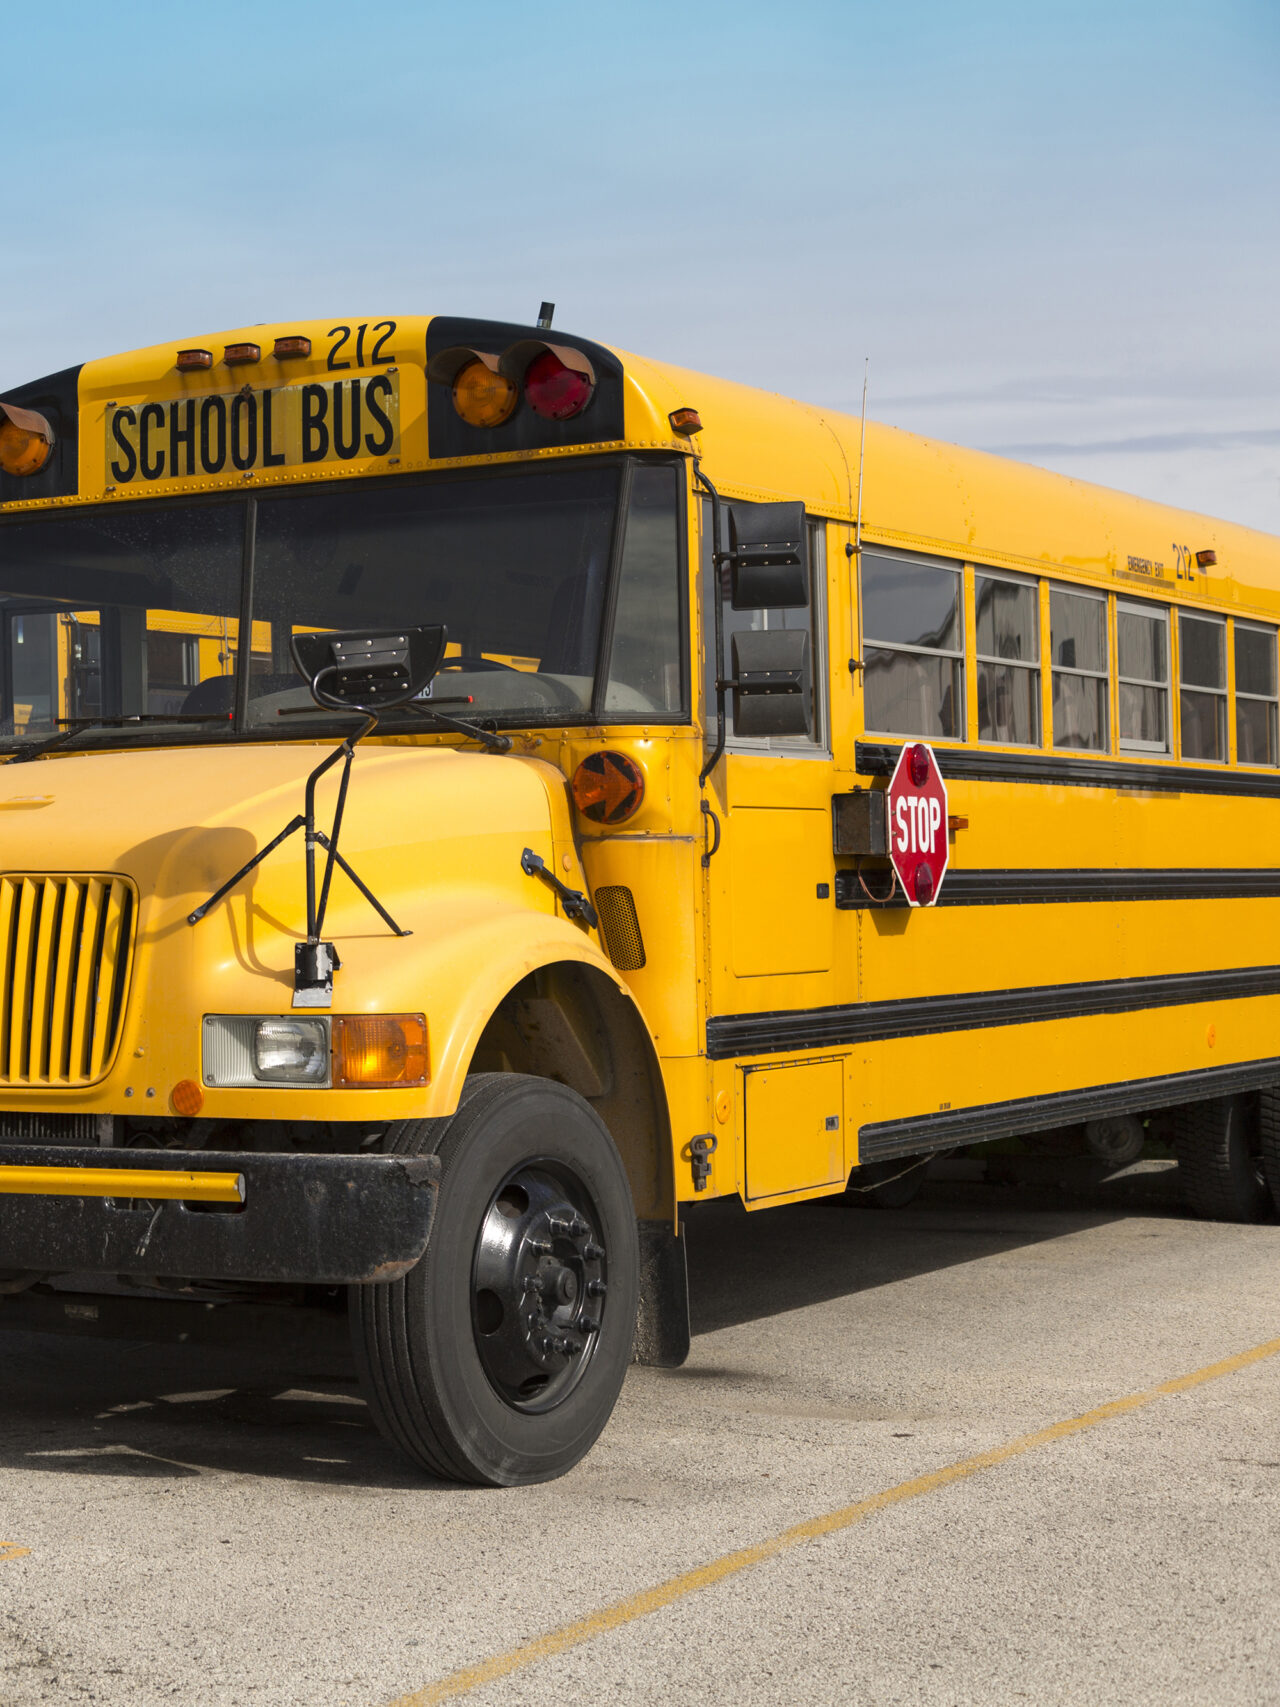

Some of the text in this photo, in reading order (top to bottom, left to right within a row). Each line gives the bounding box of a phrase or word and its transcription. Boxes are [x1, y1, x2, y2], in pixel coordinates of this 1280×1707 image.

[326, 321, 397, 371] 212
[111, 375, 394, 484] SCHOOL BUS
[1127, 554, 1153, 577] EMERGENCY
[1172, 542, 1195, 582] 212
[895, 795, 941, 853] STOP
